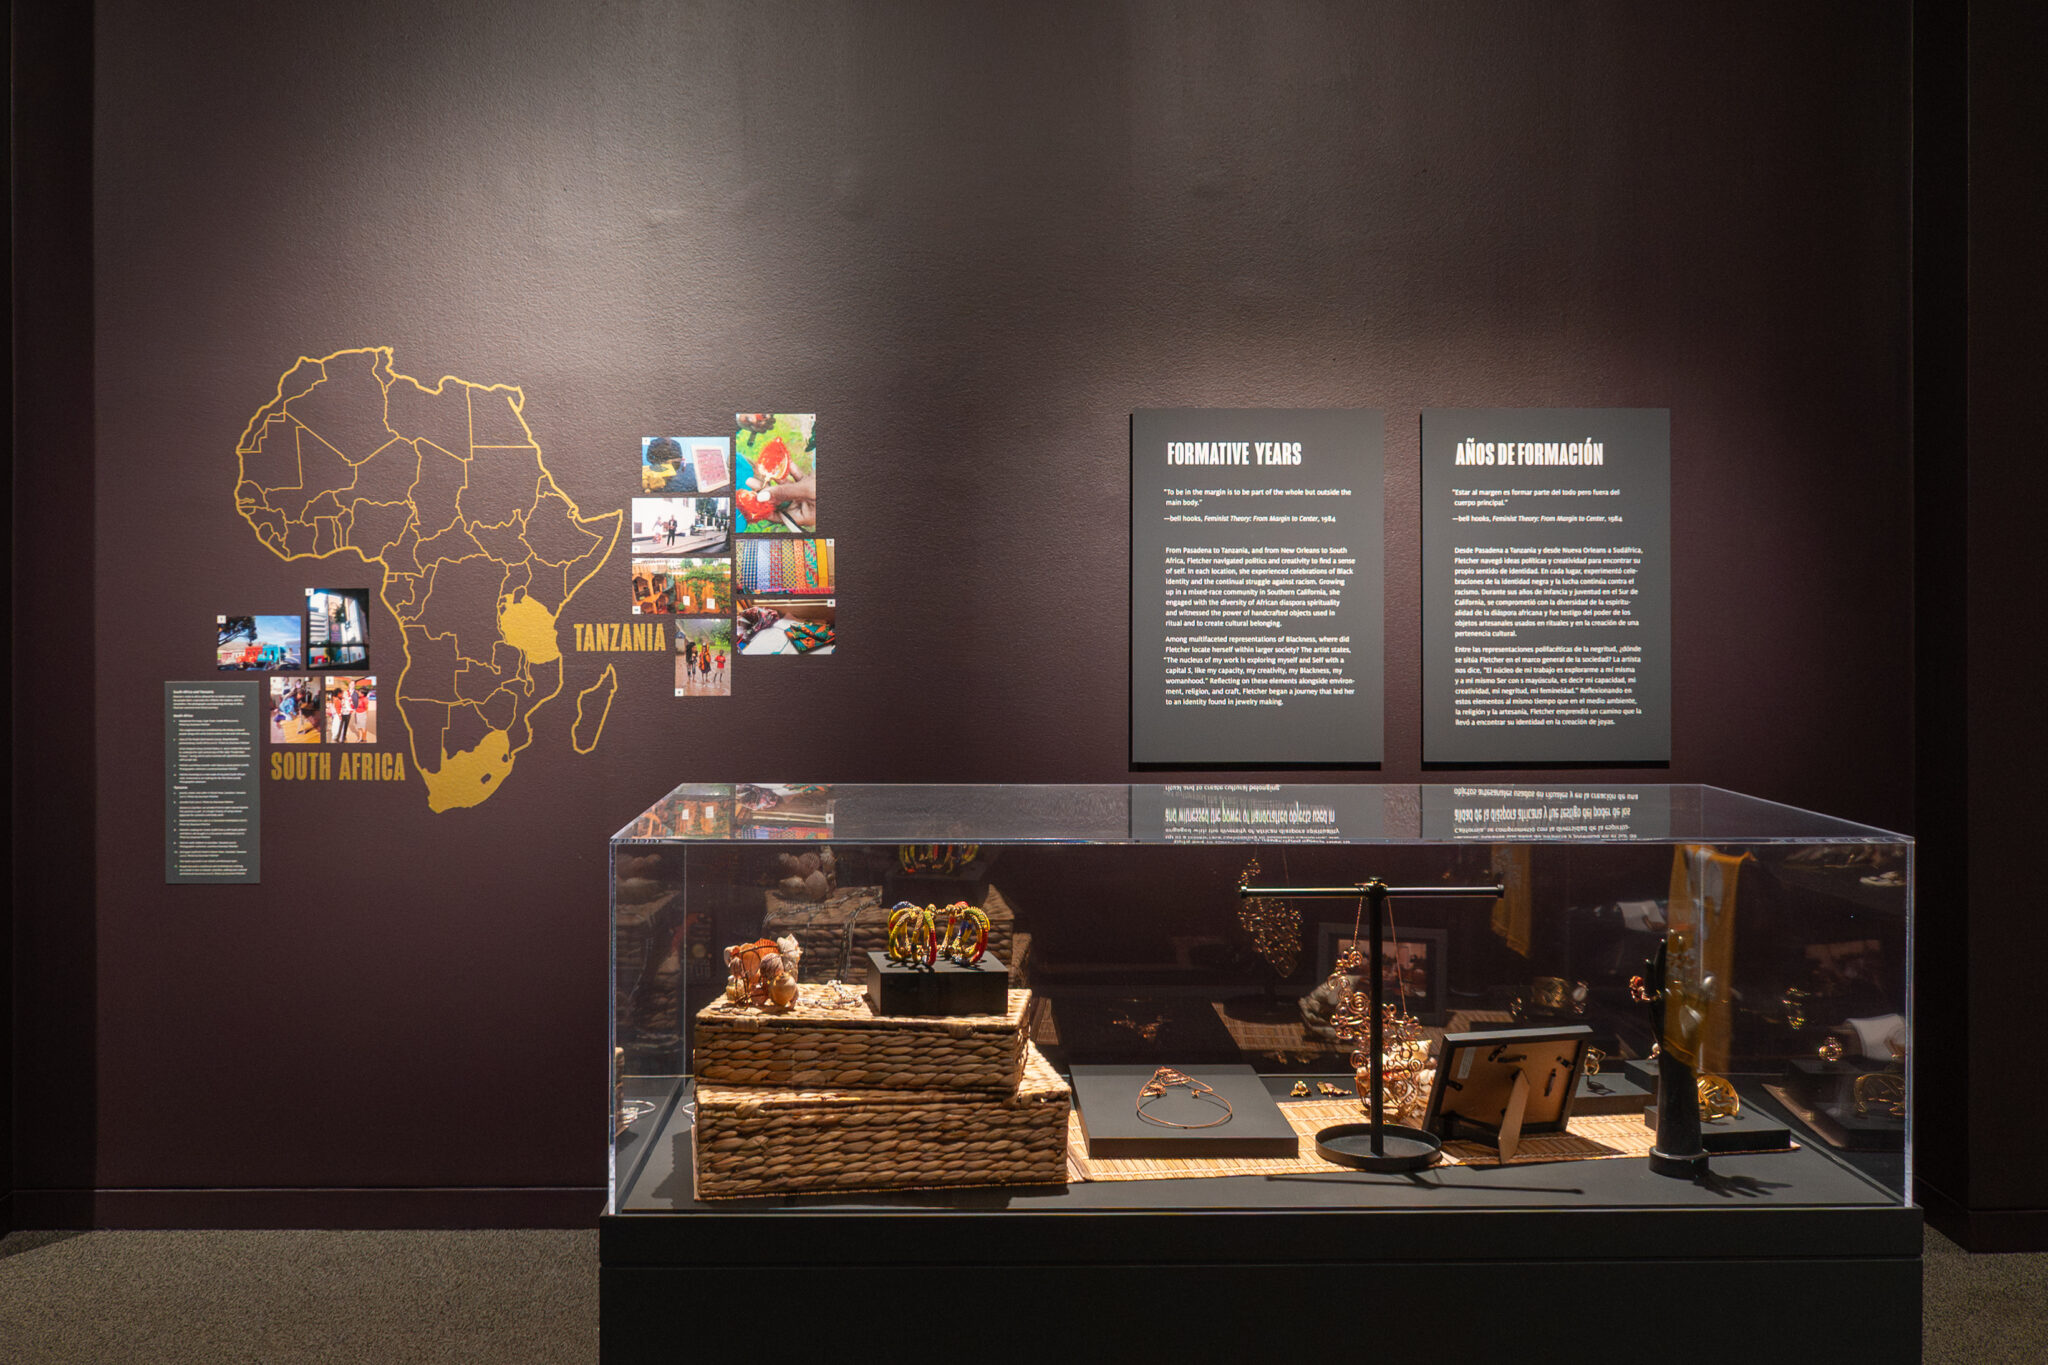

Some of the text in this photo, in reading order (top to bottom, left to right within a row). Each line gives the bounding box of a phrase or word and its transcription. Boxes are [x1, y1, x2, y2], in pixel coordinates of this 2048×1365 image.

[1167, 442, 1302, 466] FORMATIVE YEARS
[1455, 437, 1604, 466] AÑOS DE FORMACIÓN
[1176, 488, 1183, 496] be
[1185, 488, 1191, 496] in
[1192, 488, 1202, 496] the
[1204, 488, 1226, 497] margin
[1227, 488, 1232, 496] is
[1234, 488, 1240, 496] to
[1242, 488, 1250, 496] be
[1251, 488, 1264, 497] part
[1265, 488, 1272, 496] of
[1273, 488, 1283, 496] the
[1285, 488, 1303, 496] whole
[1305, 488, 1315, 496] but
[1316, 488, 1340, 496] outside
[1341, 488, 1351, 496] the
[1472, 488, 1478, 496] al
[1511, 488, 1532, 496] formar
[1533, 488, 1550, 497] parte
[1551, 488, 1561, 496] del
[1562, 488, 1576, 496] todo
[1592, 488, 1609, 496] fuera
[1610, 488, 1620, 496] del
[1182, 514, 1202, 523] hooks,
[1204, 514, 1228, 522] Feminist
[1230, 514, 1251, 523] Theory:
[1253, 514, 1268, 522] From
[1269, 514, 1290, 523] Margin
[1291, 514, 1298, 522] to
[1299, 514, 1319, 523] Center,
[1321, 514, 1336, 524] 1984
[1492, 514, 1517, 522] Feminist
[1518, 514, 1540, 523] Theory:
[1540, 514, 1556, 522] From
[1556, 514, 1578, 523] Margin
[1578, 514, 1585, 522] to
[1608, 514, 1622, 524] 1984
[1165, 546, 1181, 554] From
[1183, 546, 1212, 554] Pasadena
[1213, 546, 1220, 554] to
[1251, 546, 1263, 554] and
[1264, 546, 1279, 554] from
[1280, 546, 1294, 554] New
[1296, 546, 1320, 554] Orleans
[1321, 546, 1328, 554] to
[1329, 546, 1347, 554] South
[1187, 556, 1211, 564] Fletcher
[1213, 556, 1243, 566] navigated
[1244, 556, 1266, 566] politics
[1268, 556, 1280, 564] and
[1281, 556, 1310, 566] creativity
[1311, 556, 1318, 564] to
[1319, 556, 1331, 564] find
[1165, 567, 1172, 575] of
[1188, 567, 1194, 575] In
[1195, 567, 1210, 575] each
[1239, 567, 1250, 575] she
[1251, 567, 1288, 576] experienced
[1290, 567, 1327, 575] celebrations
[1328, 567, 1335, 575] of
[1336, 567, 1353, 575] Black
[1165, 577, 1189, 586] identity
[1191, 577, 1202, 585] and
[1204, 577, 1214, 585] the
[1215, 577, 1244, 585] continual
[1245, 577, 1270, 586] struggle
[1272, 577, 1294, 586] against
[1319, 577, 1345, 586] Growing
[1166, 589, 1174, 597] up
[1223, 588, 1258, 597] community
[1165, 598, 1340, 607] engaged with the diversity of African diaspora spirituality
[1165, 608, 1335, 618] and witnessed the power of handcrafted objects used in
[573, 623, 667, 652] TANZANIA
[270, 752, 406, 781] SOUTH AFRICA
